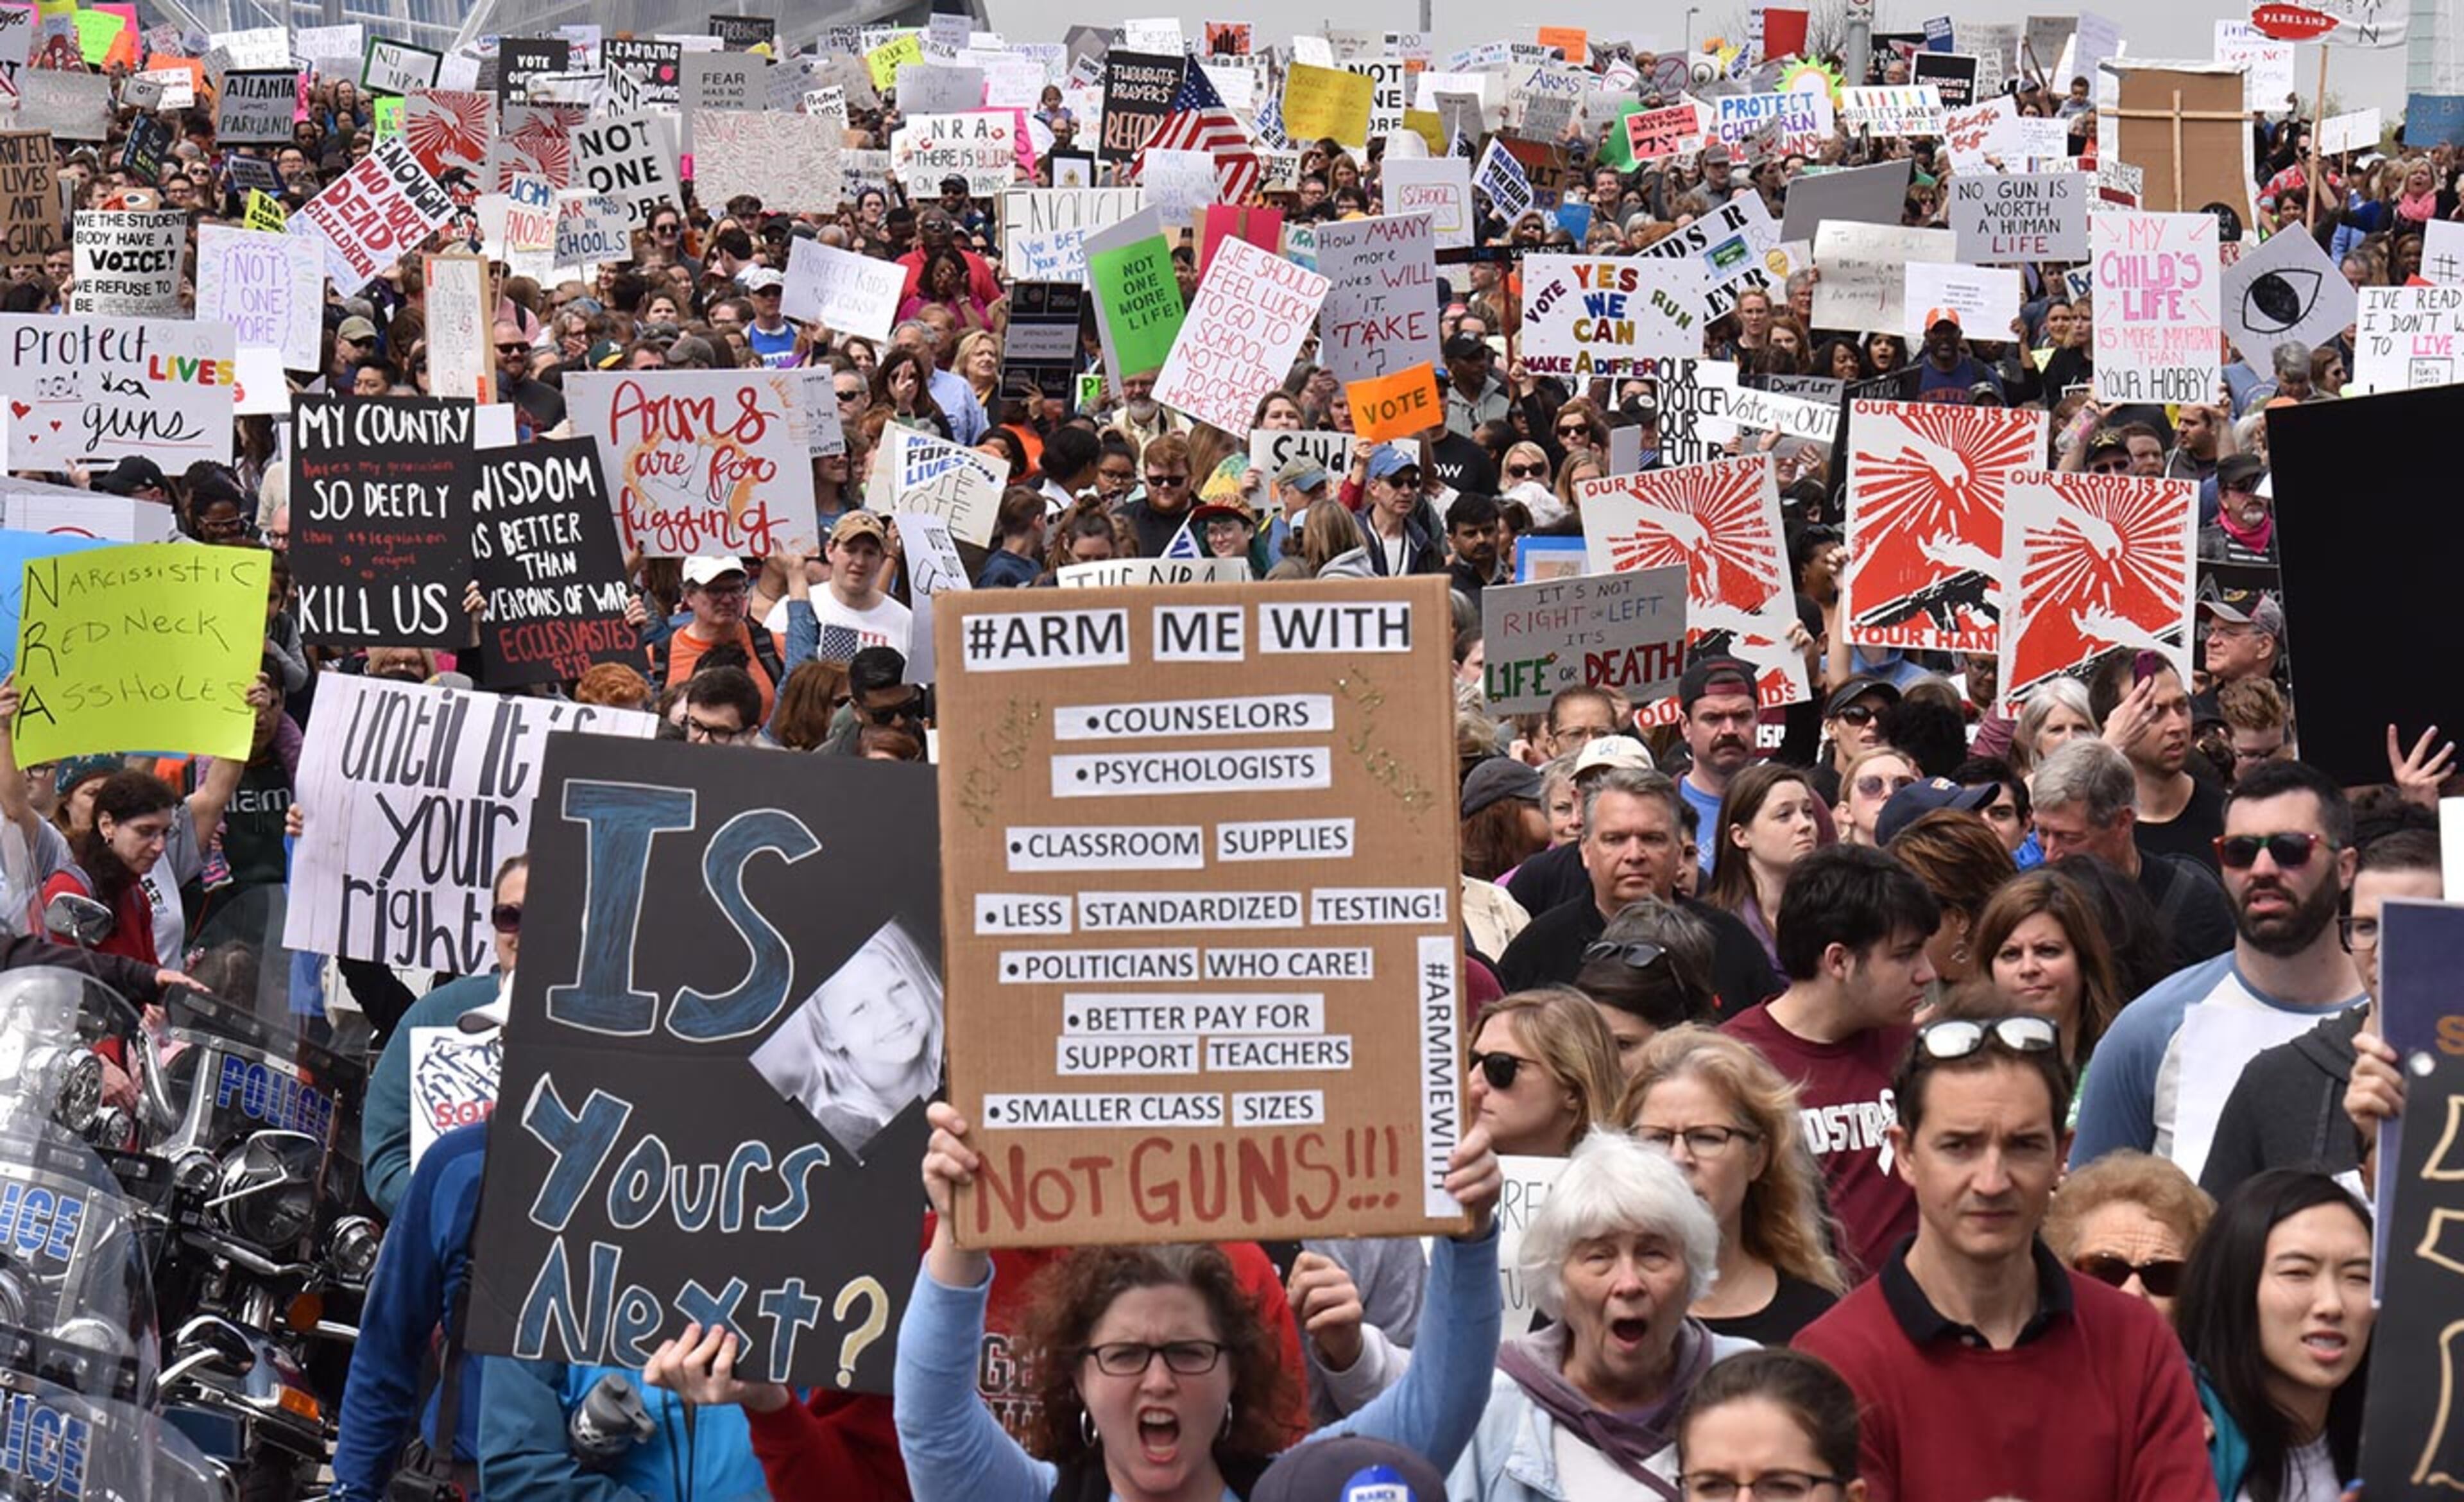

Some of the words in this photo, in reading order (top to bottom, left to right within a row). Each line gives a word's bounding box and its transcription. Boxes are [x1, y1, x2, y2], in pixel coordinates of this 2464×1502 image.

[2263, 13, 2328, 27] PARKLAND
[376, 46, 401, 67] NO
[517, 55, 550, 69] VOTE
[225, 76, 296, 99] ATLANTA
[702, 73, 746, 85] FEAR
[1525, 68, 1581, 94] ARMS
[1917, 76, 1971, 89] THOUGHTS
[1721, 92, 1815, 121] PROTECT
[578, 120, 649, 159] NOT
[587, 156, 662, 193] ONE
[914, 150, 957, 168] THERE
[2, 166, 50, 193] LIVES
[350, 157, 387, 195] NO
[373, 135, 449, 220] ENOUGH
[1958, 182, 1985, 200] NO
[1998, 179, 2041, 199] GUN
[2048, 178, 2069, 198] IS
[8, 194, 45, 221] NOT
[74, 212, 96, 228] WE
[98, 212, 124, 228] THE
[127, 212, 189, 229] STUDENT
[321, 179, 394, 252] DEAD
[1983, 201, 2051, 220] WORTH
[6, 223, 55, 257] GUNS
[75, 230, 112, 246] BODY
[116, 230, 156, 246] HAVE
[164, 234, 174, 246] A
[304, 198, 377, 279] CHILDREN
[1319, 232, 1357, 250] How
[1364, 215, 1432, 246] MANY
[1976, 220, 1990, 234] A
[2000, 218, 2062, 235] HUMAN
[2128, 218, 2168, 252] MY
[89, 248, 177, 274] VOICE!
[1352, 248, 1398, 267] more
[1991, 236, 2049, 255] LIFE
[232, 253, 281, 286] NOT
[1122, 254, 1156, 279] NOT
[1218, 238, 1253, 269] WE
[1253, 255, 1328, 298] SHOULD
[1380, 262, 1434, 289] WILL
[2099, 250, 2203, 290] CHILD'S
[96, 279, 153, 297] REFUSE
[155, 279, 173, 295] TO
[241, 287, 284, 313] ONE
[1123, 275, 1159, 297] ONE
[1208, 265, 1258, 307] FEEL
[1259, 286, 1315, 329] LUCKY
[1524, 279, 1568, 325] VOTE
[1572, 264, 1640, 293] YES
[1650, 289, 1694, 332] RUN
[2416, 288, 2463, 310] READ
[74, 297, 94, 313] BE
[1118, 288, 1167, 316] MORE
[1128, 300, 1182, 332] LIFE!
[1582, 292, 1628, 320] WE
[2121, 288, 2187, 321] LIFE
[228, 314, 277, 343] MORE
[1224, 302, 1257, 332] GO
[1263, 316, 1293, 347] TO
[1331, 311, 1430, 349] TAKE
[1572, 319, 1636, 345] CAN
[2389, 311, 2442, 333] DON'T
[13, 324, 151, 367] Protect
[1177, 341, 1231, 376] NOT
[1192, 319, 1269, 371] SCHOOL
[2134, 350, 2187, 365] THAN
[2370, 336, 2393, 356] TO
[2412, 334, 2454, 356] LIVE
[148, 354, 235, 386] LIVES
[1523, 356, 1573, 374] MAKE
[1574, 350, 1596, 375] A
[1658, 358, 1699, 390] OUR
[1810, 381, 1836, 395] LET
[2098, 367, 2143, 401] YOUR
[2149, 367, 2214, 403] HOBBY
[610, 379, 780, 446] Arms
[1362, 388, 1430, 426] VOTE
[1793, 406, 1840, 436] OUT
[1854, 399, 1901, 419] OUR
[1905, 402, 1978, 422] BLOOD
[1982, 408, 2001, 424] IS
[2009, 408, 2041, 425] ON
[81, 402, 207, 453] guns
[298, 403, 347, 450] MY
[354, 402, 472, 448] COUNTRY
[1658, 413, 1699, 442] OUR
[905, 446, 952, 467] FOR
[905, 456, 966, 487] LIVES
[472, 455, 598, 513] WISDOM
[633, 449, 691, 478] are
[709, 443, 777, 502] for
[1584, 478, 1628, 498] OUR
[1634, 465, 1702, 489] BLOOD
[1736, 454, 1768, 476] ON
[2010, 469, 2053, 488] OUR
[2060, 472, 2130, 491] BLOOD
[2135, 476, 2156, 493] IS
[2162, 478, 2194, 496] ON
[309, 479, 355, 521] SO
[363, 481, 451, 519] DEEPLY
[472, 523, 492, 559] IS
[499, 512, 583, 557] BETTER
[612, 485, 791, 558] hugging
[515, 551, 578, 582] THAN
[563, 583, 584, 616] OF
[586, 580, 630, 614] WAR
[1536, 583, 1587, 605] IT'S
[1596, 579, 1634, 598] NOT
[296, 584, 381, 636] KILL
[391, 583, 449, 636] US
[1503, 605, 1587, 637] RIGHT
[1608, 596, 1664, 623] LEFT
[498, 617, 637, 664] ECCLESIASTES
[968, 612, 1126, 660] #ARM
[1161, 611, 1240, 653] ME
[1271, 605, 1411, 650] WITH
[1564, 631, 1605, 648] IT'S
[1849, 626, 1926, 646] YOUR
[1484, 657, 1553, 700] LIFE
[1559, 666, 1579, 682] OR
[1585, 639, 1684, 687] DEATH
[1104, 702, 1310, 734] COUNSELORS
[341, 687, 470, 790] until
[1093, 754, 1315, 785] PSYCHOLOGISTS
[375, 790, 520, 890] your
[1028, 831, 1201, 858] CLASSROOM
[1222, 824, 1349, 855] SUPPLIES
[546, 777, 824, 1043] IS
[1004, 902, 1064, 928] LESS
[1085, 896, 1299, 926] STANDARDIZED
[1317, 894, 1442, 922] TESTING!
[1025, 953, 1195, 980] POLITICIANS
[1208, 952, 1279, 978] WHO
[1288, 950, 1369, 977] CARE!
[1086, 1005, 1186, 1032] BETTER
[1194, 1005, 1250, 1032] PAY
[1256, 1003, 1310, 1029] FOR
[1065, 1044, 1195, 1069] SUPPORT
[1211, 1040, 1351, 1066] TEACHERS
[217, 1053, 335, 1152] POLICE
[1005, 1098, 1132, 1125] SMALLER
[1140, 1094, 1222, 1122] CLASS
[1243, 1094, 1314, 1121] SIZES
[520, 1071, 831, 1233] Yours
[975, 1144, 1113, 1234] NOT
[1128, 1125, 1401, 1227] GUNS!!!
[512, 1235, 889, 1389] Next?
